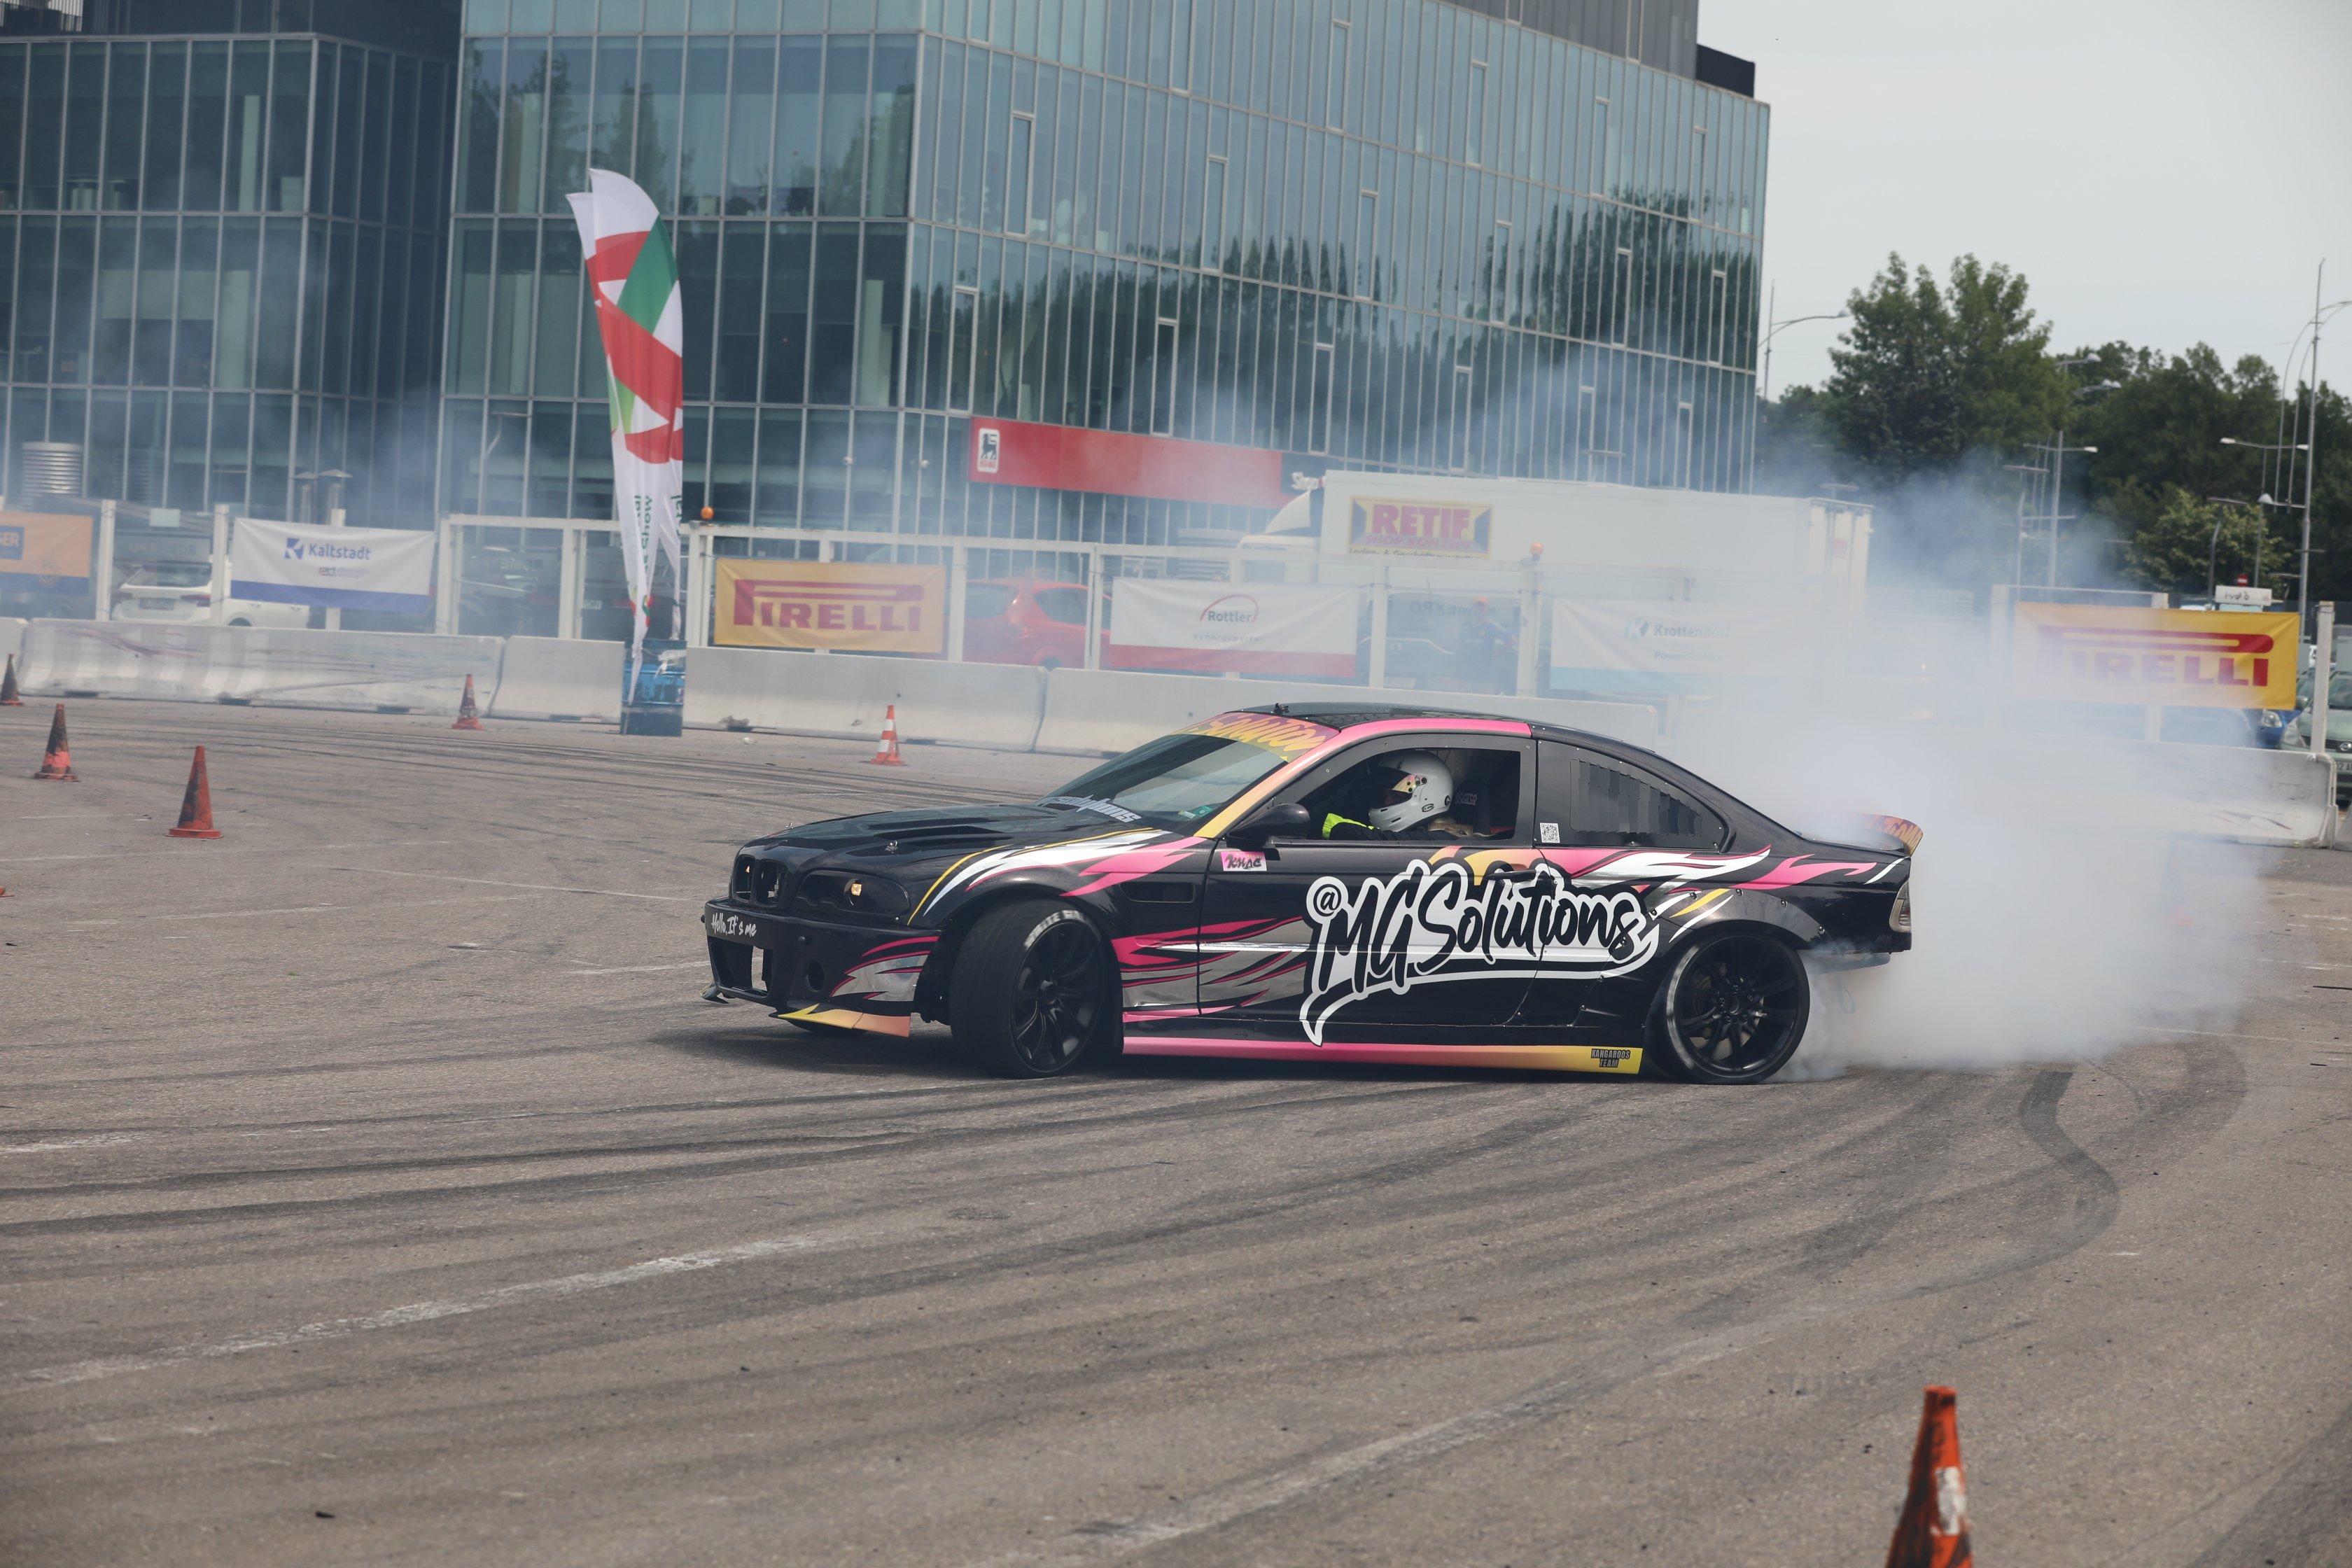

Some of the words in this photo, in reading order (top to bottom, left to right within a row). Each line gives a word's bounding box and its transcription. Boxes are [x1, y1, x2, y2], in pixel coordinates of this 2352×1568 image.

[1371, 504, 1471, 539] RETIF
[1364, 533, 1404, 545] SHOP
[1407, 537, 1472, 550] KONZEPT
[309, 543, 372, 560] Kaltstadt
[734, 579, 925, 632] PIRELLI
[1208, 610, 1252, 622] Rottler
[1653, 624, 1732, 638] Krottendorf
[2037, 624, 2274, 687] PIRELLI
[745, 923, 757, 938] me
[1591, 1049, 1630, 1059] KANGAROOS
[1599, 1058, 1619, 1068] TEAM
